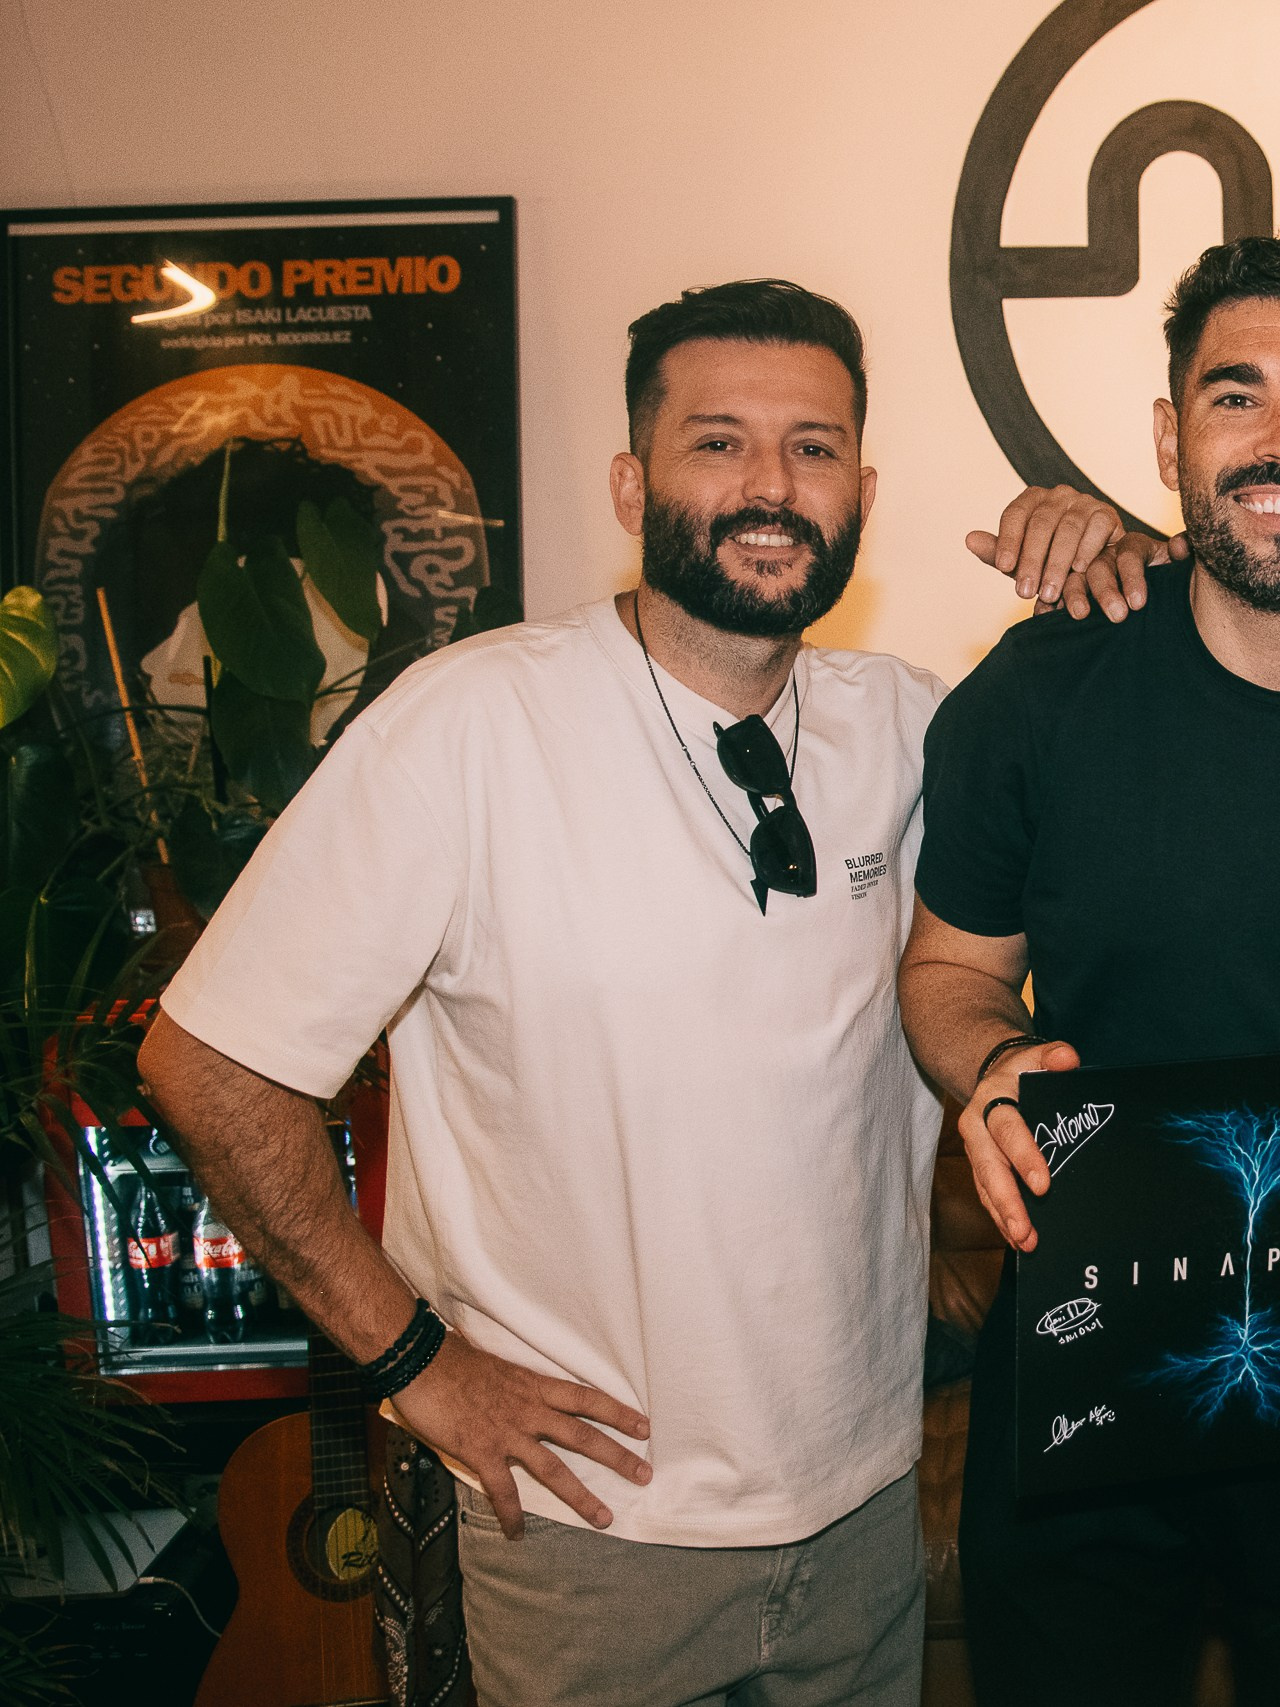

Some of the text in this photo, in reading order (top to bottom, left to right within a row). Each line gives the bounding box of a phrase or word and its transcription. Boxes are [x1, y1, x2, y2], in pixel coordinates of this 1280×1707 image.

[282, 255, 461, 298] PREMIO
[236, 307, 282, 324] ISAKI
[285, 304, 372, 323] LACUESTA
[845, 852, 883, 869] BLURRED
[850, 865, 887, 883] MEMORIES
